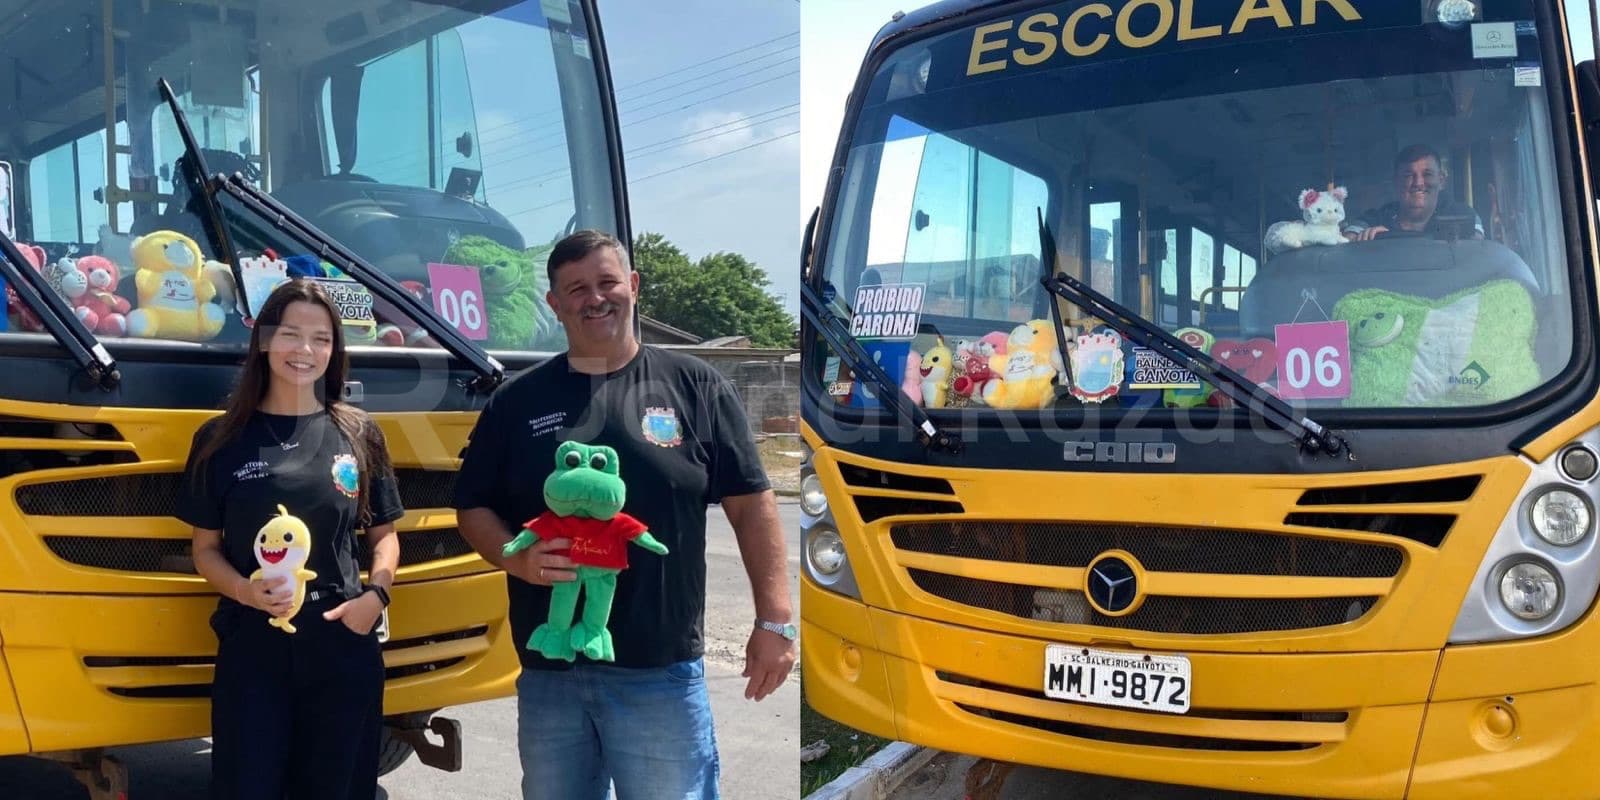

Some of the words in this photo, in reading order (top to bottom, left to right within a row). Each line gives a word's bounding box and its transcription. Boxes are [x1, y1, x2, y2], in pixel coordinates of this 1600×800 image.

[440, 288, 482, 330] 06
[855, 287, 922, 314] PROIBIDO
[851, 314, 916, 337] CARONA
[1134, 368, 1199, 383] GAIVOTA
[1285, 346, 1342, 389] 06
[1448, 375, 1479, 385] BNDES
[1064, 441, 1176, 463] CAIO
